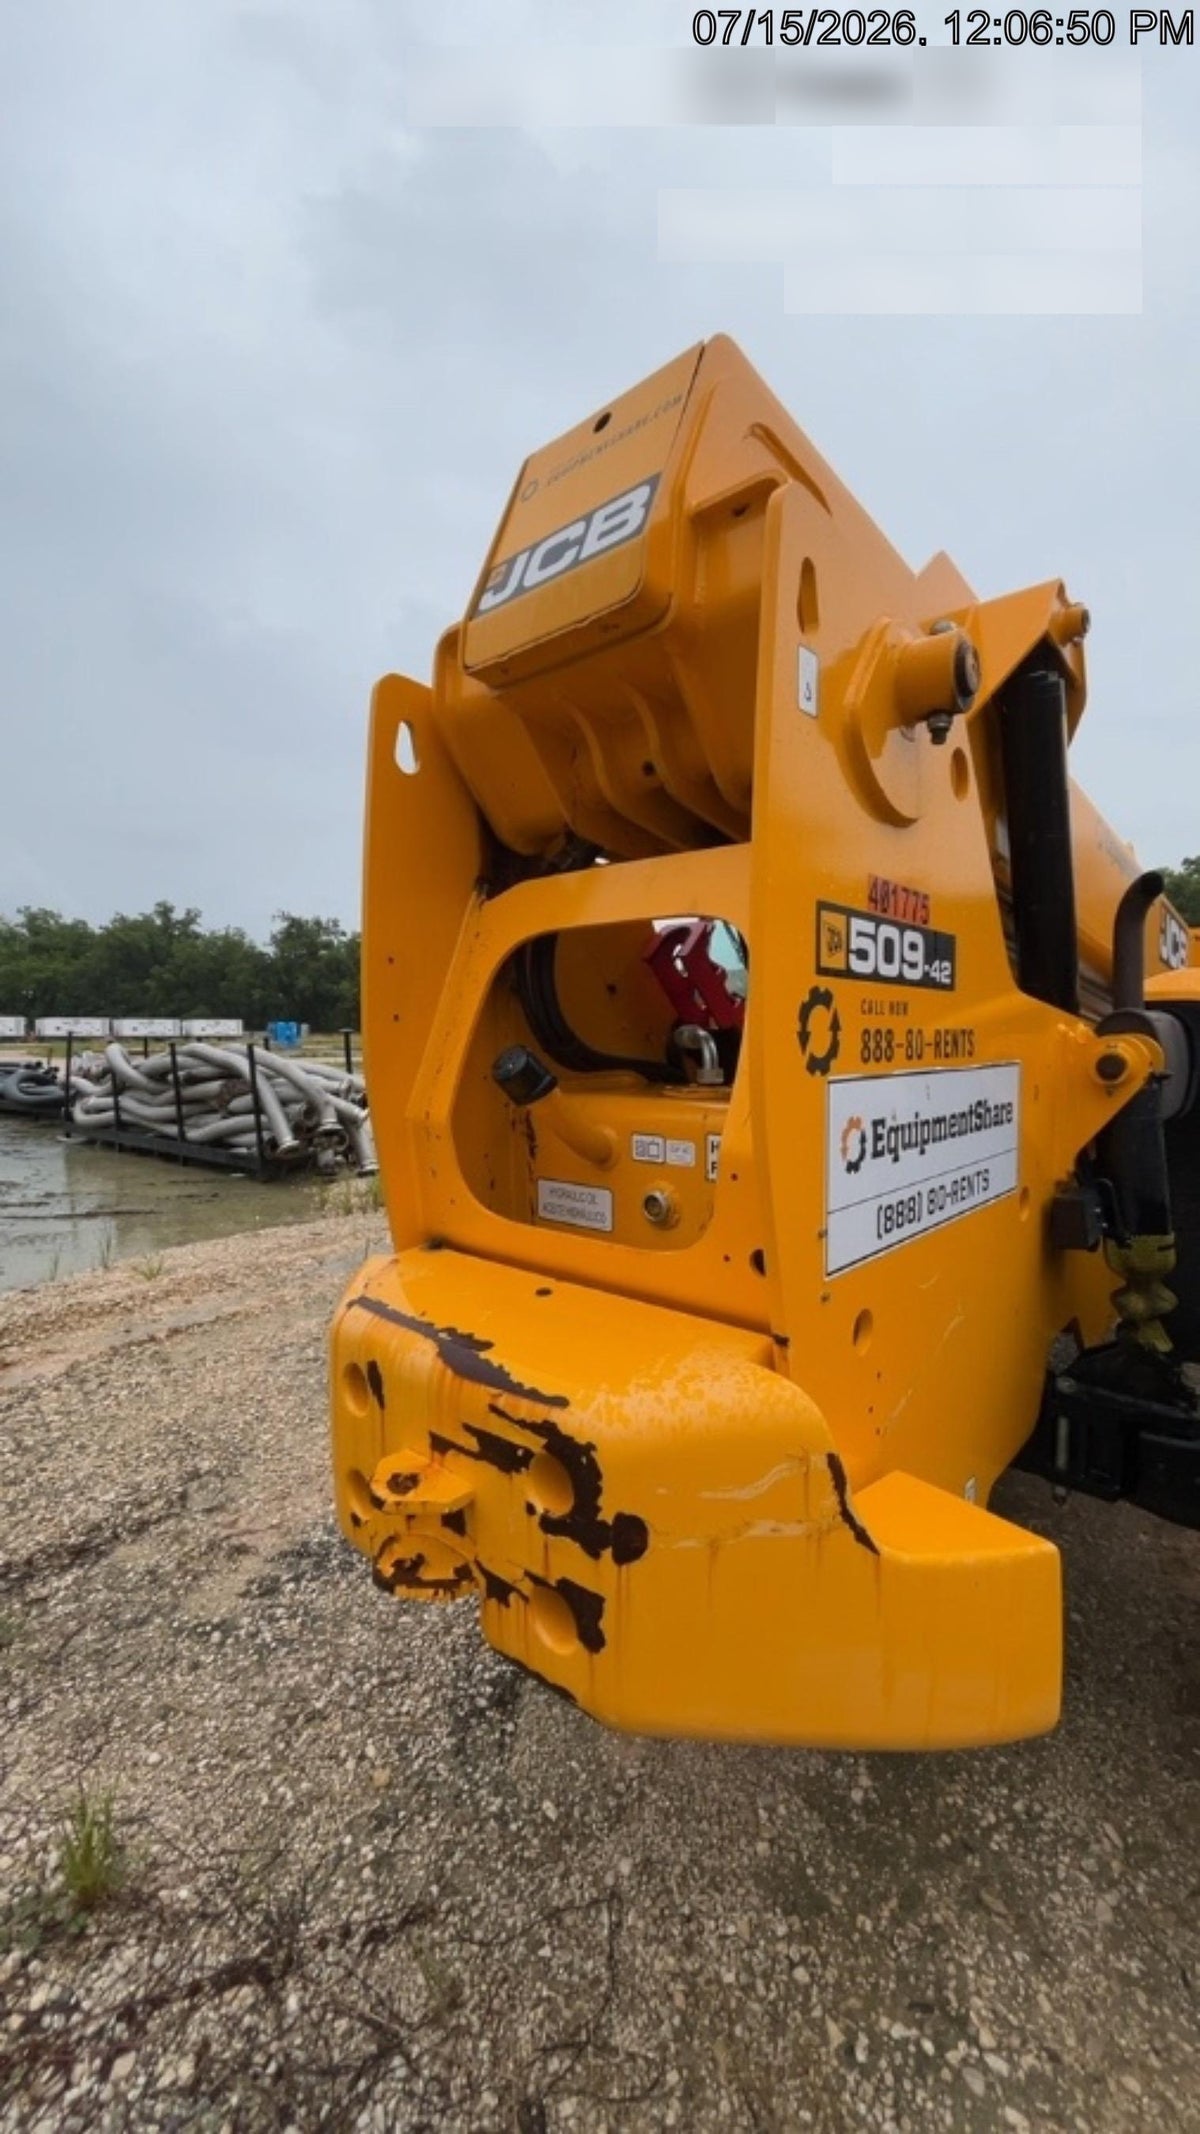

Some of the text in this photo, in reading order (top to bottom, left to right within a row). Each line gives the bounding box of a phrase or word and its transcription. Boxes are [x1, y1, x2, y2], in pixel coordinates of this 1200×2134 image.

[477, 483, 652, 613] JCB
[860, 998, 885, 1016] CALL
[860, 1027, 976, 1064] 888-80-RENTS
[870, 1098, 1014, 1164] EquipmentShare
[876, 1167, 990, 1241] (888) 80-RENTS
